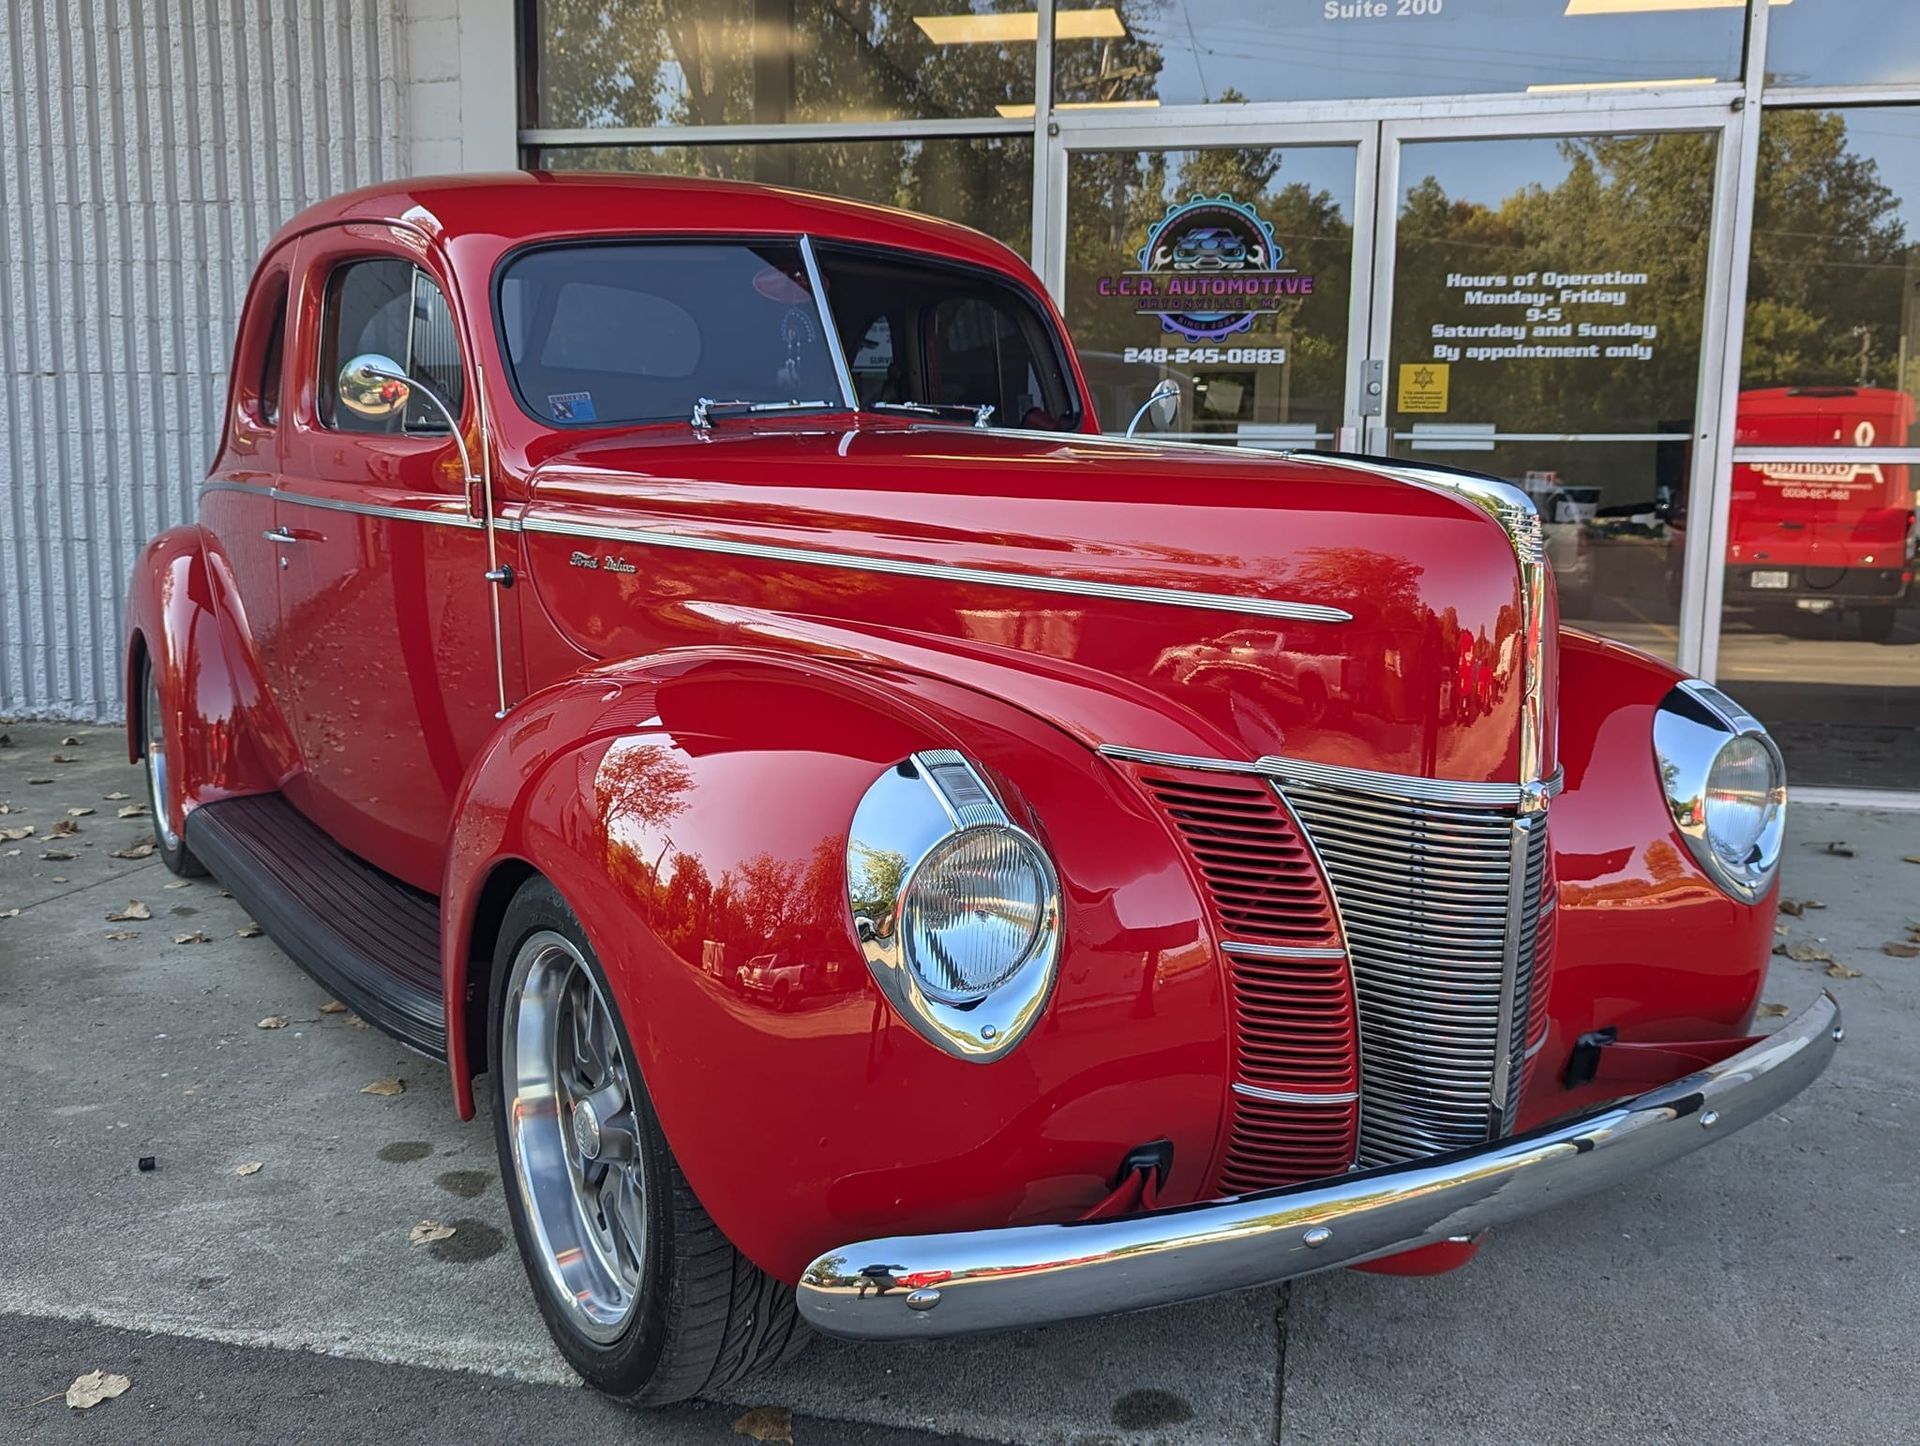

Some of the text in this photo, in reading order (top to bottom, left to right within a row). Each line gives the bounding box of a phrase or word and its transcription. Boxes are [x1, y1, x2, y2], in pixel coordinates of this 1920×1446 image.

[1324, 0, 1443, 19] Suite 200
[1098, 276, 1313, 296] C.C.R. AUTOMOTIVE
[1446, 271, 1648, 287] Hours of Operation
[1464, 289, 1627, 307] Monday- Friday
[1526, 307, 1562, 322] 9-5
[1431, 322, 1657, 340] Saturday and Sunday
[1123, 347, 1286, 365] 248-245-0883
[1433, 344, 1653, 361] By appointment only
[569, 551, 599, 569] Ford
